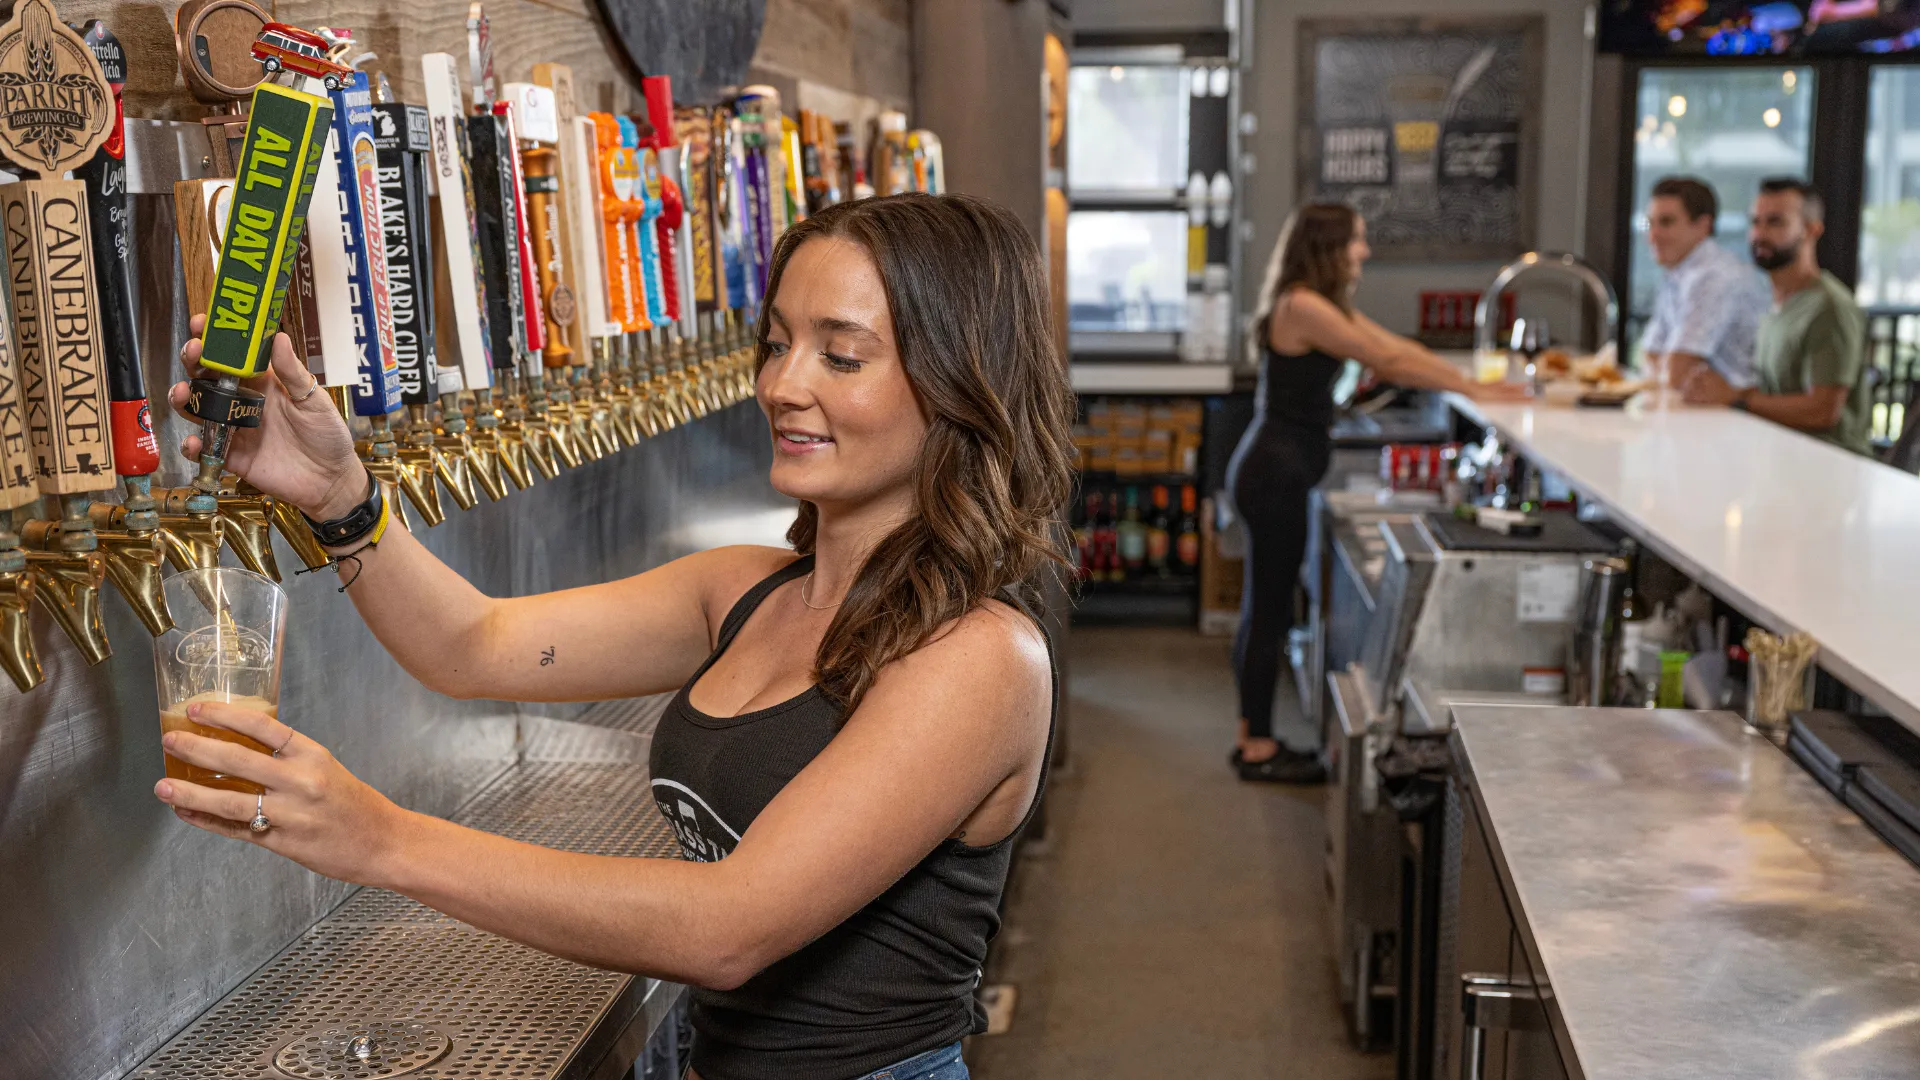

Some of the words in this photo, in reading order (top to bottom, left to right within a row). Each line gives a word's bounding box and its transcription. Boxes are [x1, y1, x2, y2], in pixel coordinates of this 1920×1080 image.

[56, 35, 87, 69] LOUISIANA
[88, 42, 120, 60] strella
[101, 61, 121, 78] licia
[2, 83, 90, 119] PARISH
[12, 111, 65, 126] BREWING
[101, 162, 126, 196] Lag
[245, 124, 293, 192] ALL
[229, 202, 277, 275] DAY
[364, 184, 385, 287] FRICTION
[377, 165, 409, 258] BLAKE'S
[300, 229, 312, 299] APE
[7, 199, 50, 447] CANEBRAKE
[42, 197, 102, 446] CANEBRAKE
[212, 277, 261, 331] IPA
[378, 294, 393, 350] PULP
[387, 264, 414, 325] HARD
[396, 330, 421, 395] CIDER
[227, 400, 260, 420] Found
